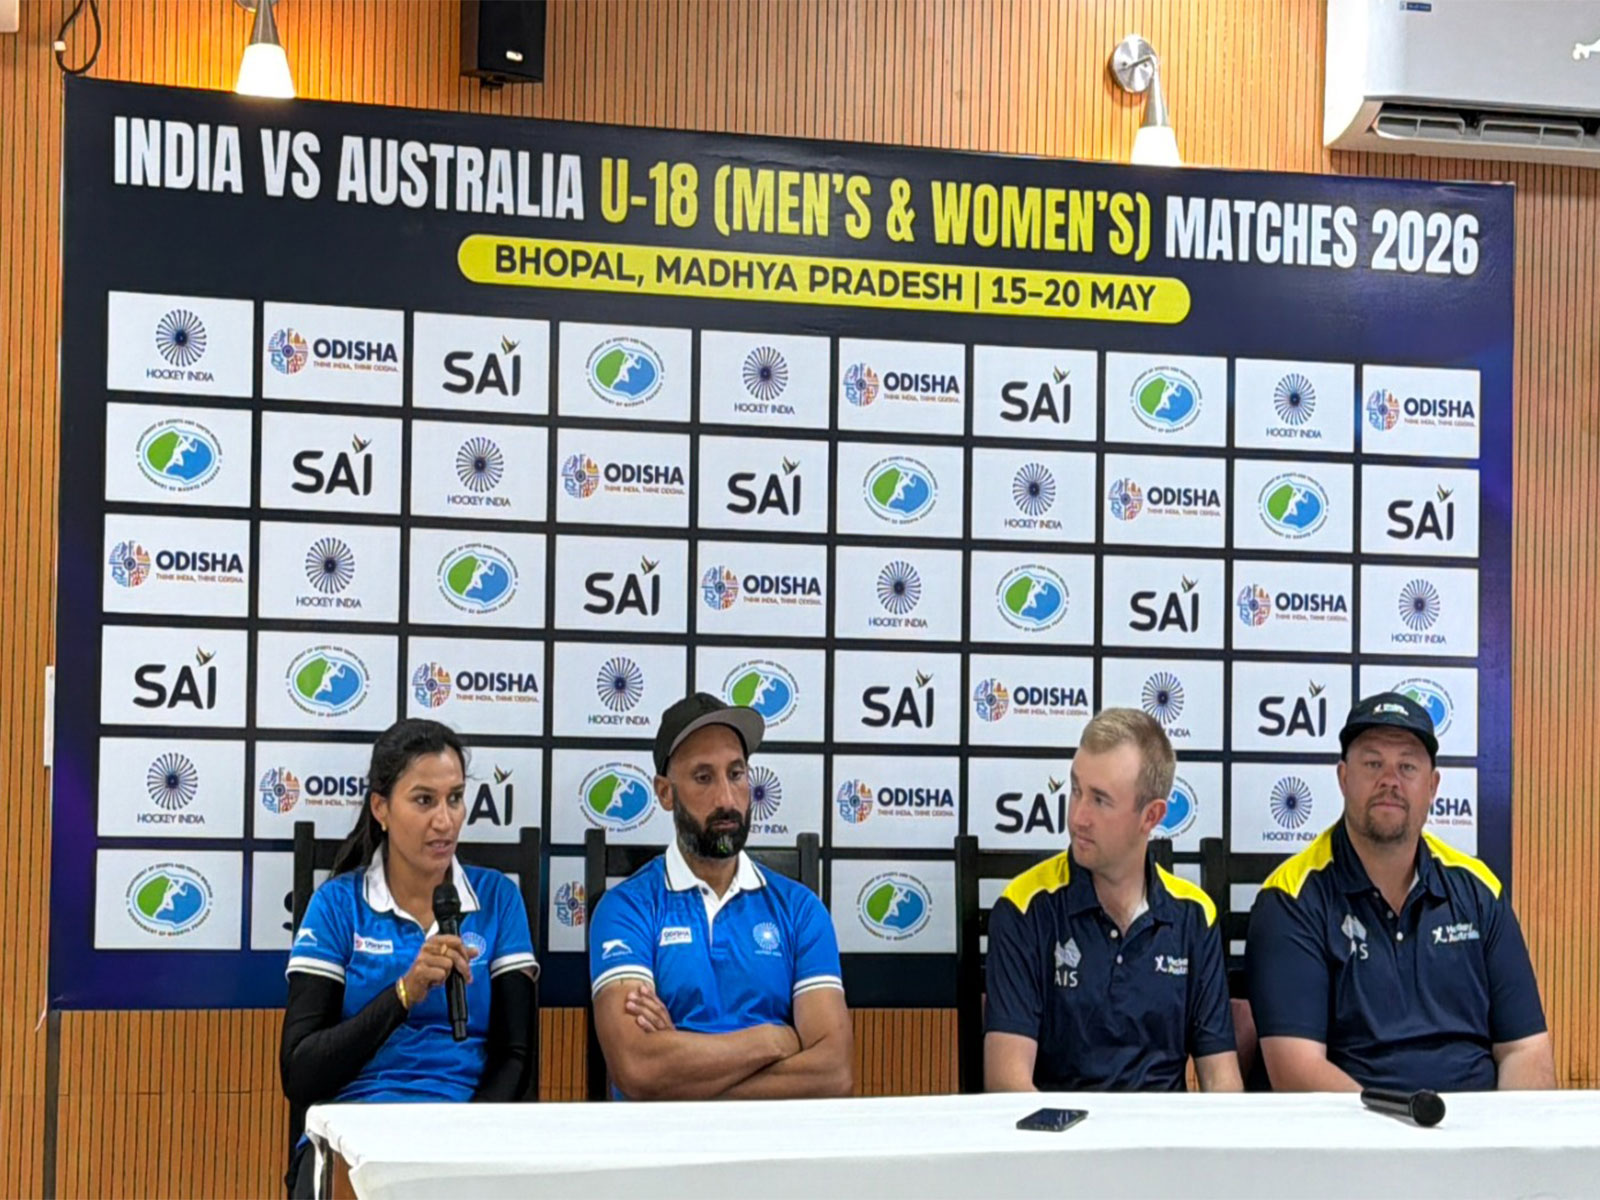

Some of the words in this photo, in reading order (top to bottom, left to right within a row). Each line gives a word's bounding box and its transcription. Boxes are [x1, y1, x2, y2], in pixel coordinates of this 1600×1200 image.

[115, 117, 243, 193] INDIA
[261, 129, 320, 199] VS
[337, 136, 584, 220] AUSTRALIA
[601, 158, 698, 227] U-18
[886, 178, 915, 242] &
[1166, 196, 1358, 268] MATCHES
[1371, 208, 1479, 275] 2026
[495, 244, 644, 287] BHOPAL,
[657, 256, 798, 292] MADHYA
[810, 265, 962, 301] PRADESH
[1090, 282, 1156, 311] MAY
[313, 338, 398, 363] ODISHA
[146, 369, 185, 380] HOCKEY
[187, 371, 213, 382] INDIA
[443, 351, 520, 396] SAI
[883, 372, 960, 395] ODISHA
[734, 403, 769, 413] HOCKEY
[771, 405, 795, 414] INDIA
[1000, 381, 1071, 424] SAI
[1404, 397, 1475, 419] ODISHA
[1266, 428, 1298, 438] HOCKEY
[1300, 430, 1322, 438] INDIA
[292, 450, 372, 496] SAI
[604, 463, 684, 486] ODISHA
[447, 495, 484, 506] HOCKEY
[486, 497, 511, 507] INDIA
[727, 473, 801, 516] SAI
[1147, 486, 1221, 508] ODISHA
[1004, 518, 1038, 528] HOCKEY
[1039, 520, 1062, 529] INDIA
[1387, 500, 1454, 541] SAI
[155, 550, 243, 574] ODISHA
[584, 572, 660, 616] SAI
[742, 574, 821, 597] ODISHA
[296, 596, 334, 607] HOCKEY
[336, 598, 362, 608] INDIA
[1129, 591, 1199, 633] SAI
[1275, 592, 1347, 613] ODISHA
[868, 617, 903, 627] HOCKEY
[904, 619, 928, 628] INDIA
[1391, 633, 1423, 643] HOCKEY
[1425, 635, 1446, 643] INDIA
[133, 665, 216, 709] SAI
[455, 671, 538, 693] ODISHA
[861, 686, 934, 728] SAI
[1013, 686, 1088, 707] ODISHA
[588, 715, 624, 725] HOCKEY
[626, 716, 650, 725] INDIA
[1258, 696, 1326, 737] SAI
[1168, 728, 1191, 738] INDIA
[305, 775, 369, 797] ODISH
[467, 783, 513, 826] AI
[877, 787, 954, 808] ODISHA
[1430, 797, 1473, 817] ISHA
[137, 814, 177, 824] HOCKEY
[179, 815, 205, 824] INDIA
[994, 792, 1066, 835] SAI
[764, 824, 789, 834] INDIA
[1262, 831, 1295, 841] HOCKEY
